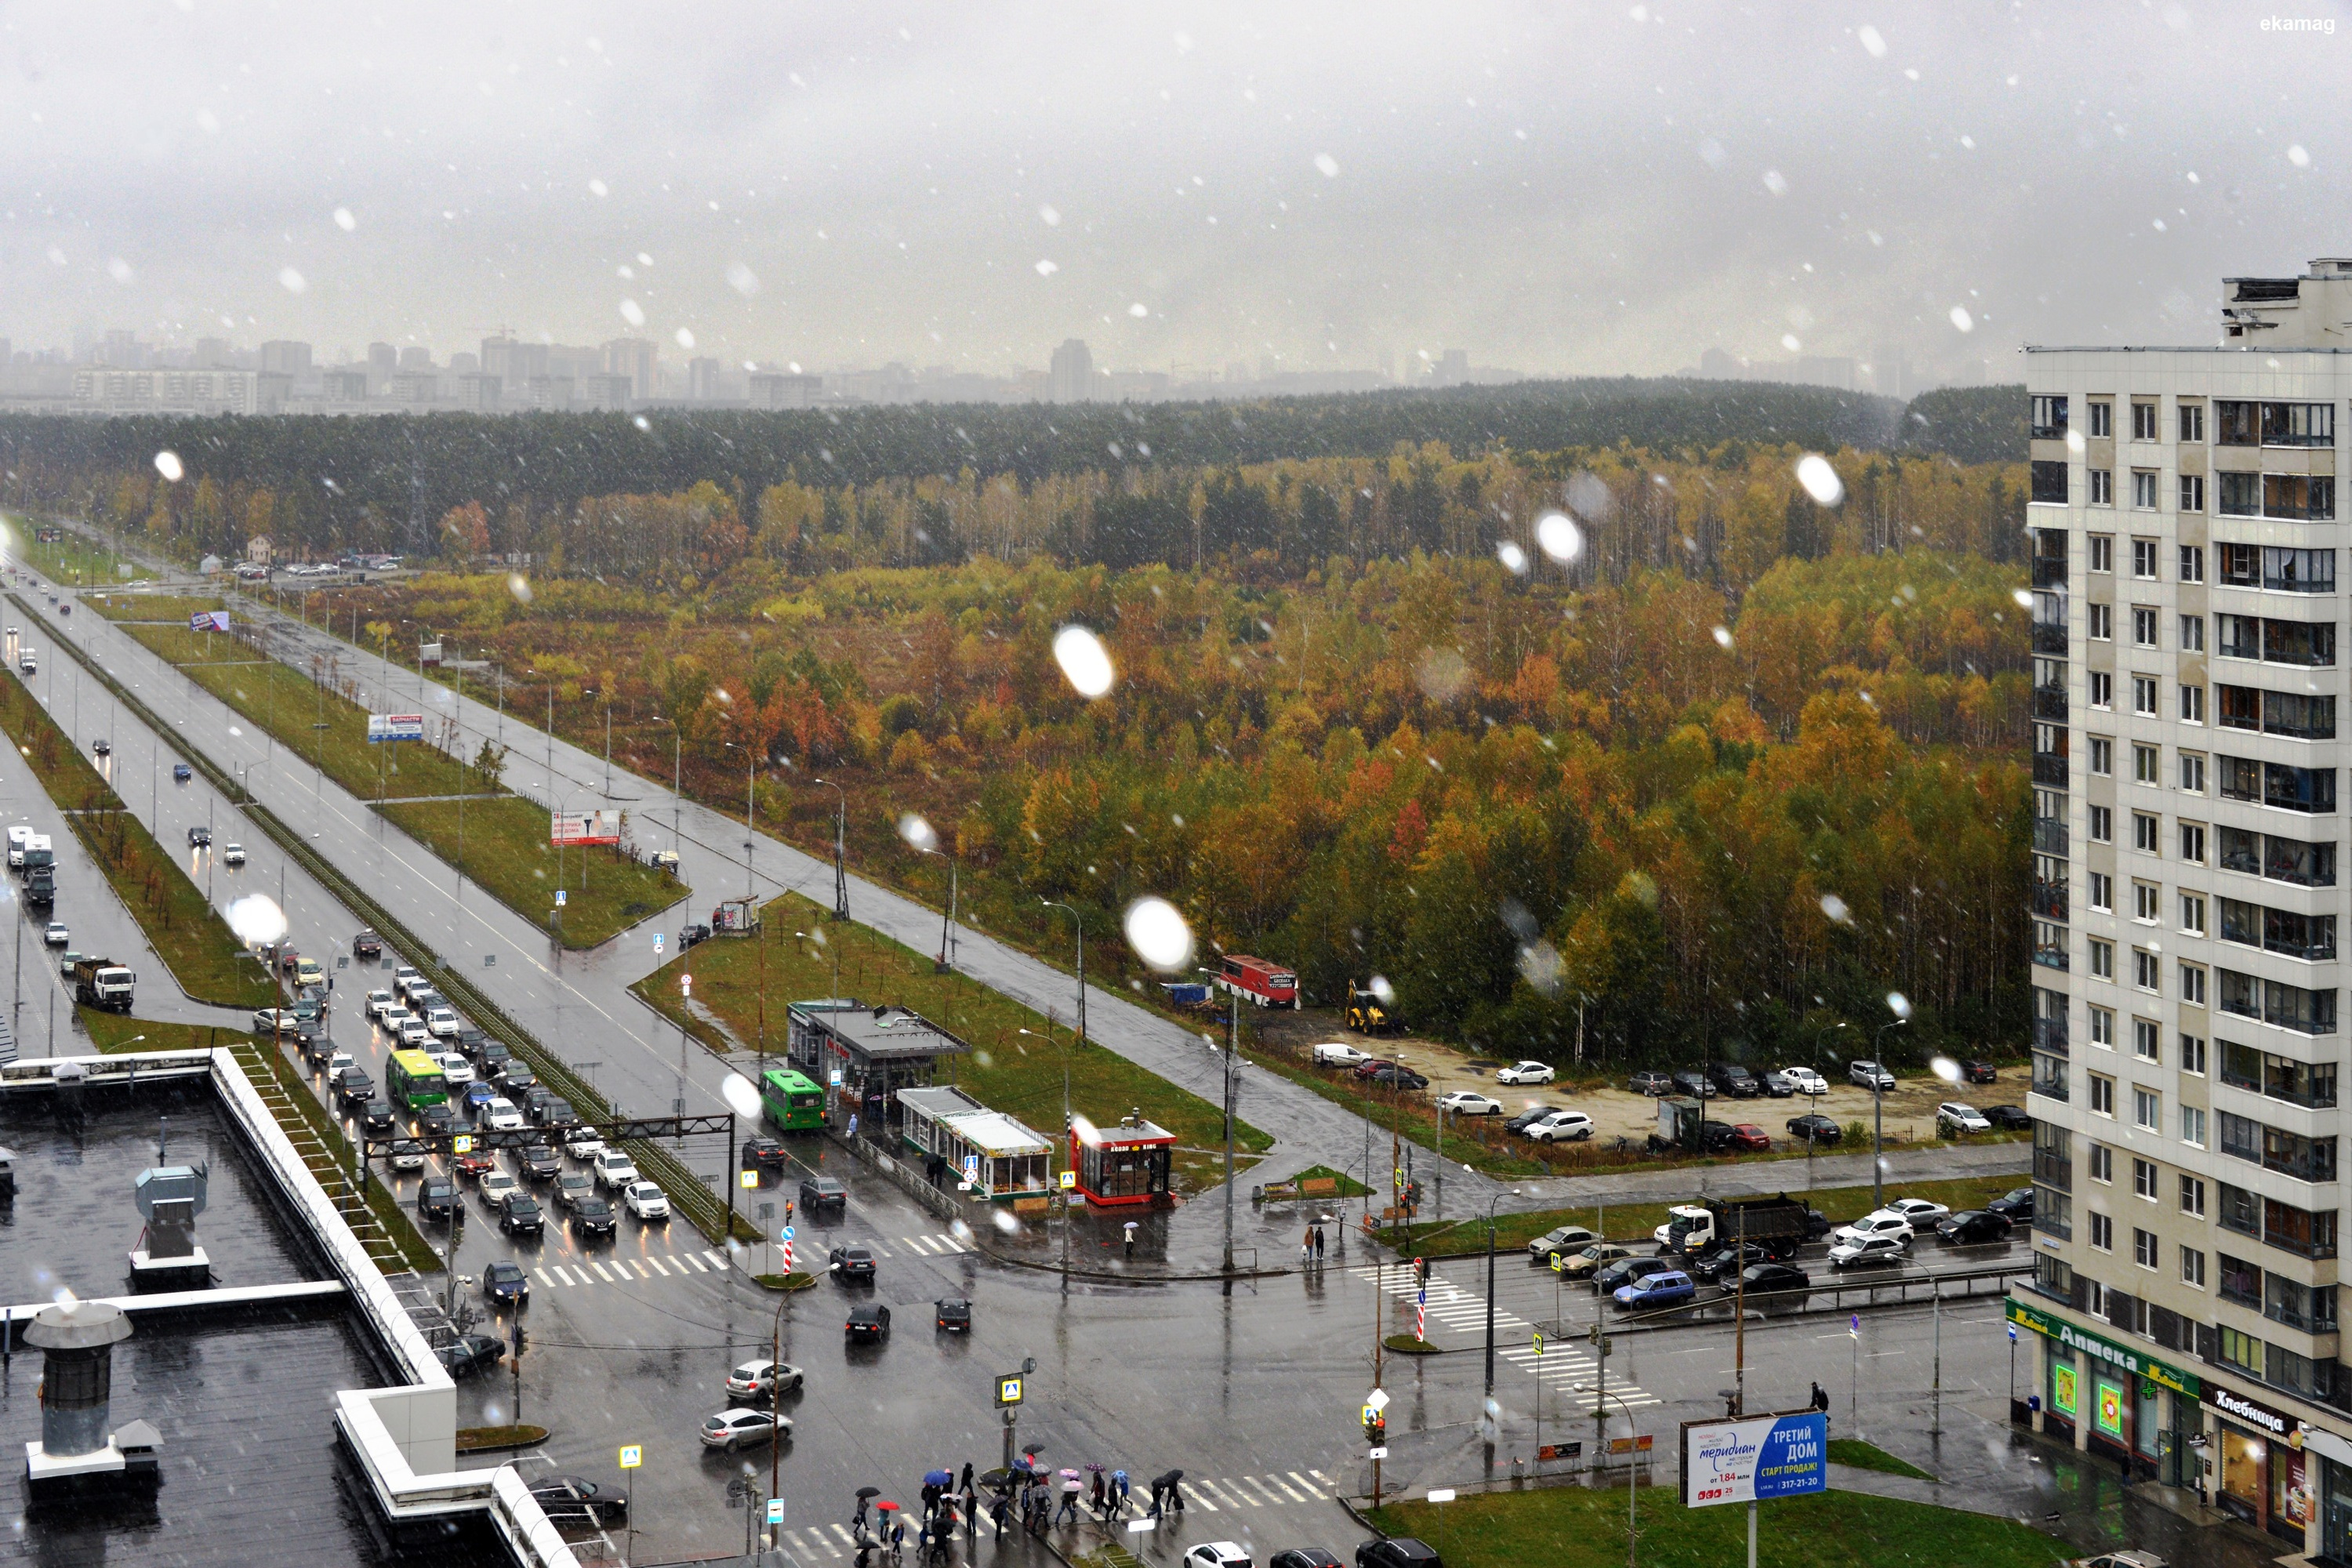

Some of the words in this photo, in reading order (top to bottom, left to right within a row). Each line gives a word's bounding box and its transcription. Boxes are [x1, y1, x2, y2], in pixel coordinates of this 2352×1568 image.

[2060, 1325, 2138, 1373] Аптека
[2216, 1390, 2285, 1432] Хлебница
[1773, 1425, 1811, 1443] ТРЕТИЙ
[1787, 1442, 1817, 1463] ДОМ
[1719, 1472, 1736, 1483] 1,84
[1761, 1466, 1783, 1477] СТАРТ
[1784, 1462, 1817, 1474] ПРОДАЖ!
[1781, 1477, 1817, 1489] 317-21-20
